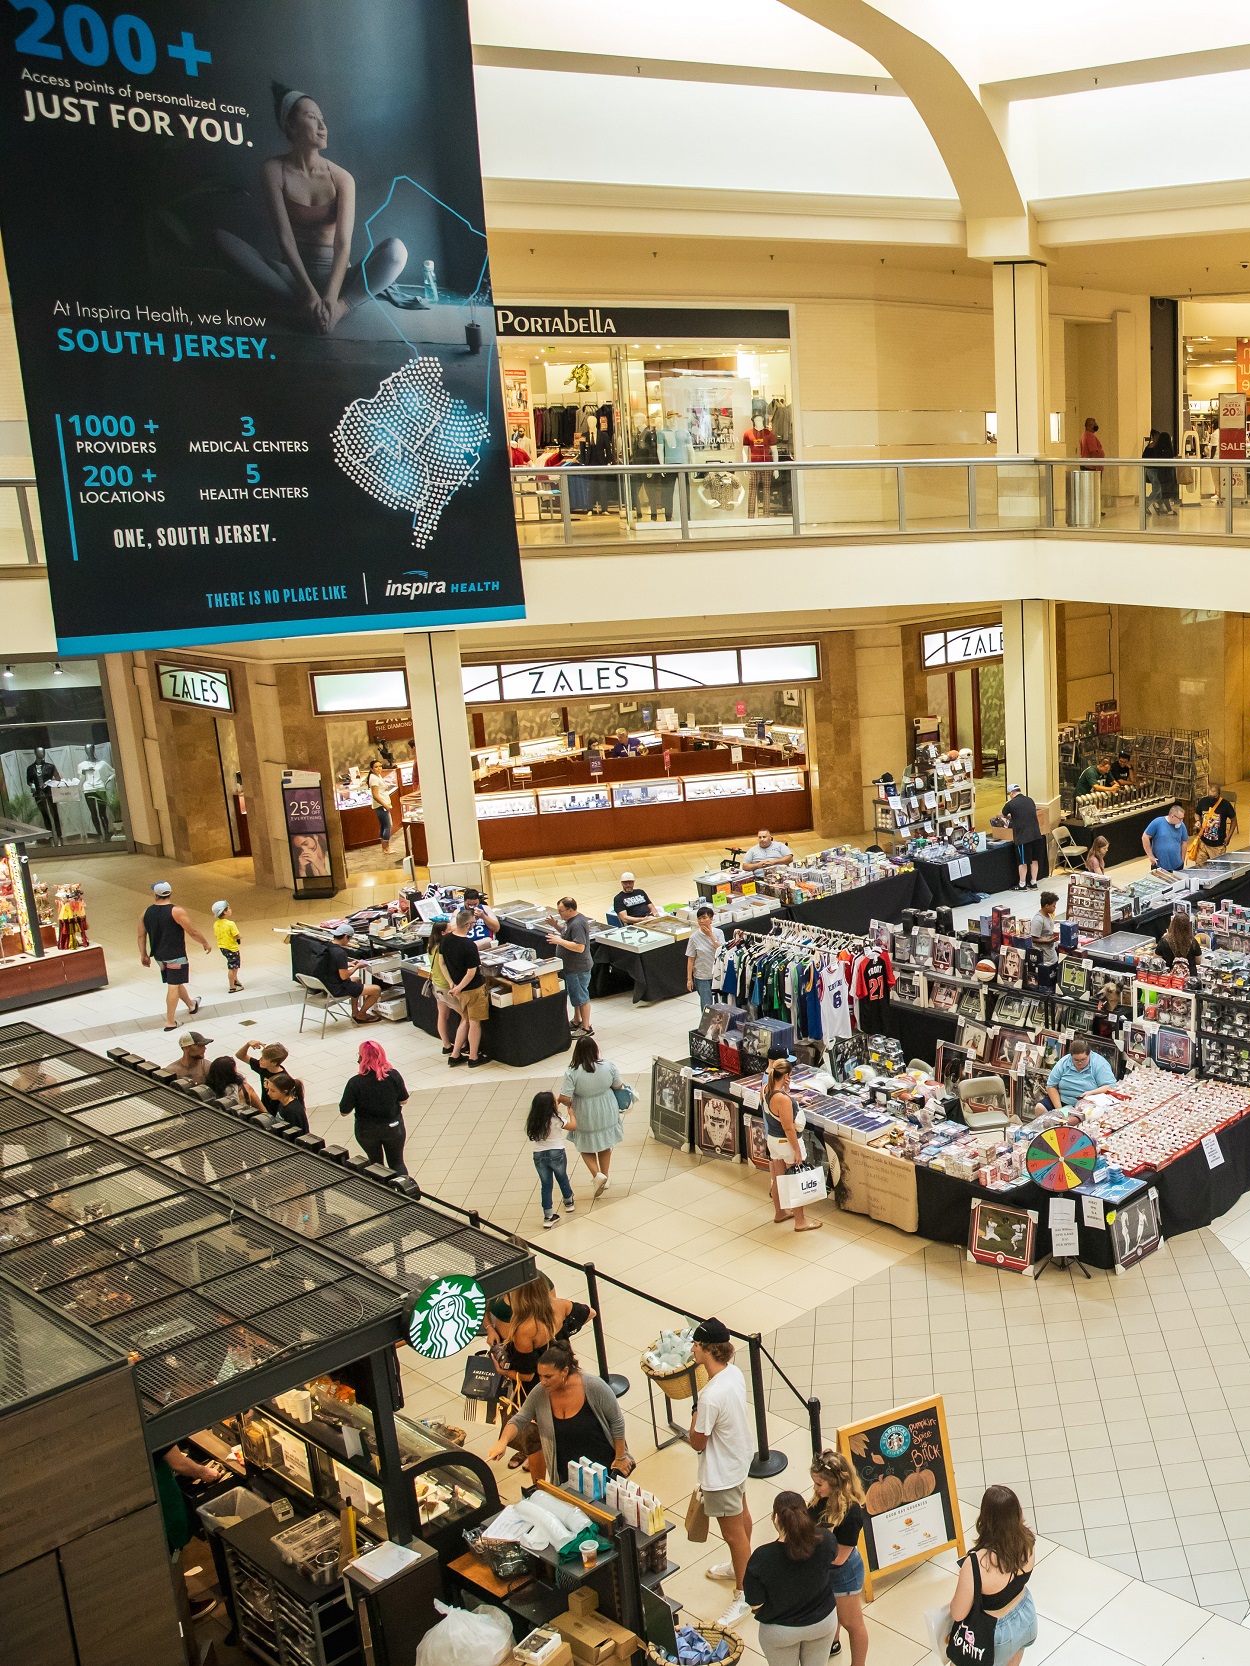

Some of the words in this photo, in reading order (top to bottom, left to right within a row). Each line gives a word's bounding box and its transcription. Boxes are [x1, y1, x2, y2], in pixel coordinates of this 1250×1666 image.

[21, 67, 71, 88] Access
[74, 80, 115, 98] points
[118, 84, 132, 98] of
[135, 90, 217, 111] personalized
[220, 102, 250, 118] care,
[23, 90, 99, 126] JUST
[109, 104, 175, 137] FOR
[179, 113, 254, 148] YOU.
[53, 300, 71, 317] At
[76, 301, 131, 323] Inspira
[136, 304, 194, 326] Health,
[197, 314, 222, 325] we
[226, 309, 267, 327] know
[57, 327, 166, 356] SOUTH
[172, 333, 277, 362] JERSEY.
[68, 415, 136, 437] 1000
[143, 419, 160, 434] +
[239, 416, 256, 437] 3
[76, 441, 157, 454] PROVIDERS
[189, 440, 250, 453] MEDICAL
[252, 440, 309, 453] CENTERS
[1220, 442, 1246, 451] SALE
[82, 465, 134, 487] 200
[141, 468, 157, 483] +
[246, 463, 261, 484] 5
[79, 490, 166, 504] LOCATIONS
[199, 488, 249, 500] HEALTH
[253, 487, 309, 499] CENTERS
[113, 528, 152, 549] ONE,
[156, 526, 210, 547] SOUTH
[215, 524, 277, 544] JERSEY.
[206, 592, 246, 609] THERE
[249, 590, 261, 605] IS
[264, 588, 280, 604] NO
[283, 586, 319, 603] PLACE
[321, 585, 348, 600] LIKE
[385, 578, 446, 600] inspira
[450, 581, 500, 593] HEALTH
[169, 674, 219, 704] ZALES
[528, 666, 629, 694] ZALES
[387, 721, 413, 731] DIAMOND
[867, 965, 883, 977] TROUT
[832, 990, 843, 1009] 6
[801, 1179, 818, 1191] Lids
[881, 1426, 908, 1444] STARBUCKS
[886, 1445, 907, 1455] COFFEE
[962, 1640, 986, 1661] KITTY
